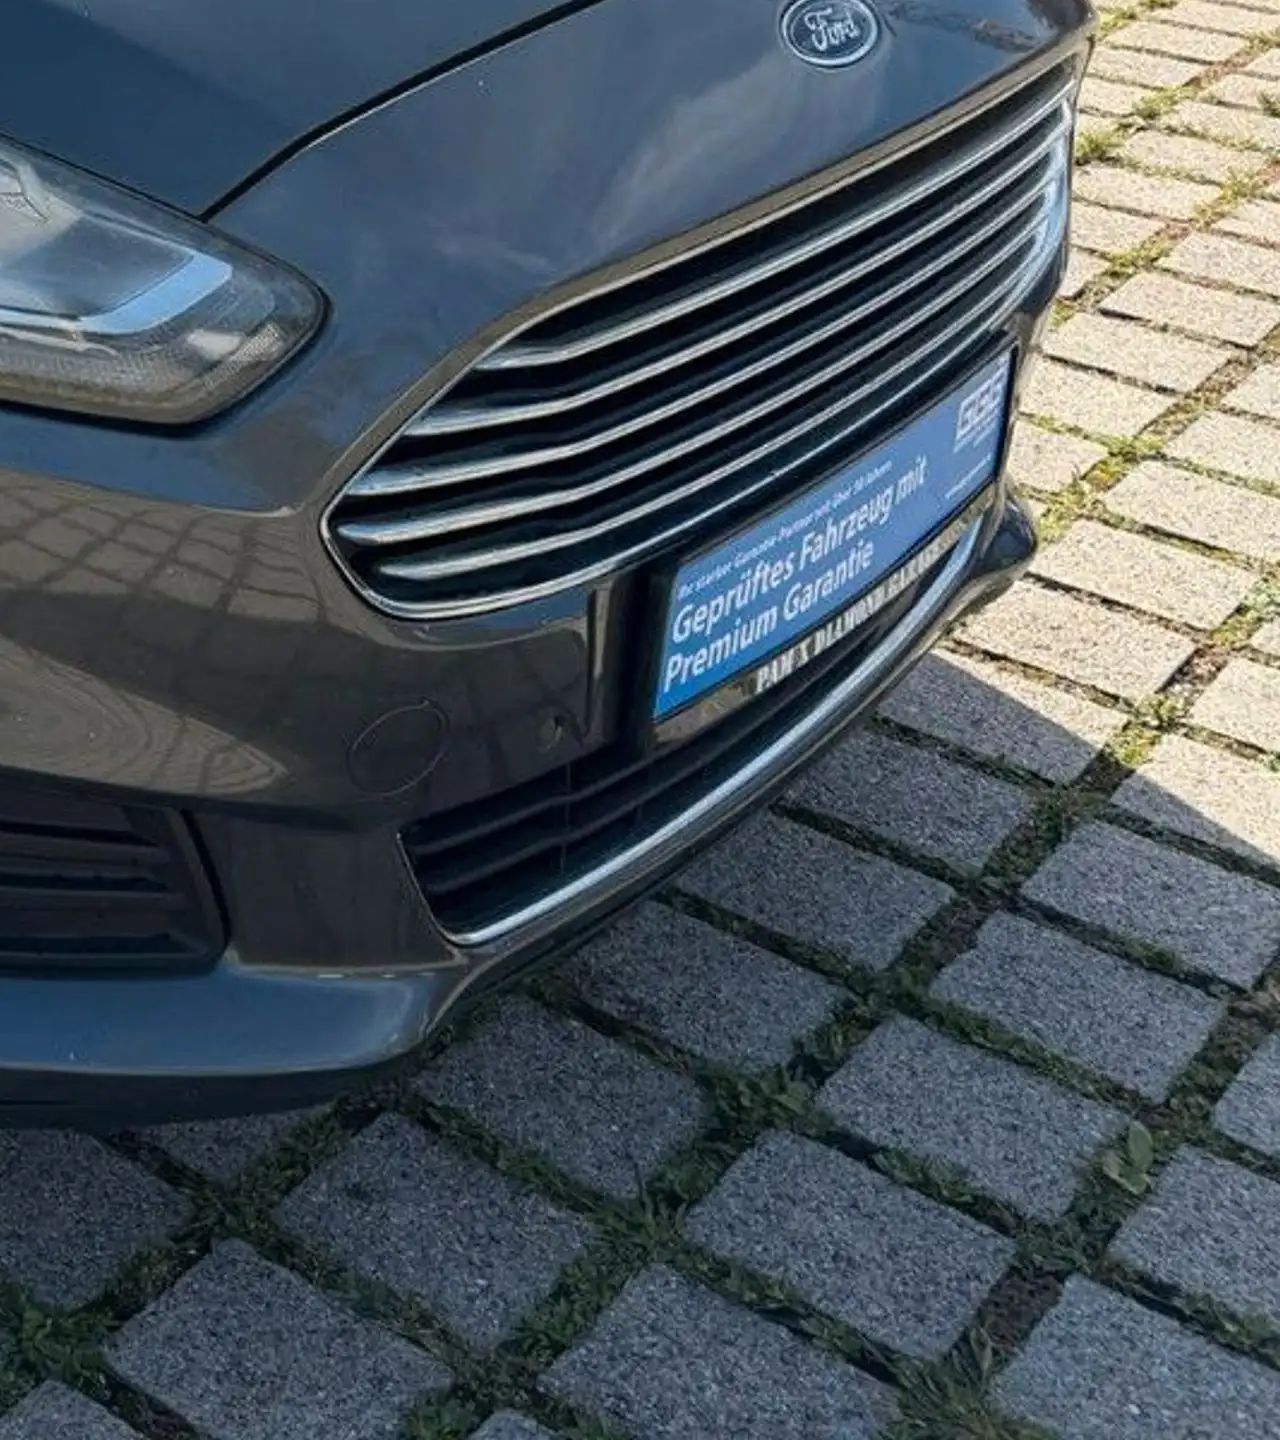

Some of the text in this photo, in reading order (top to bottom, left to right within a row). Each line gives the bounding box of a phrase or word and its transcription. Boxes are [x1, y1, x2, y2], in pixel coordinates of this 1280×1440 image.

[803, 7, 861, 52] Ford
[663, 605, 779, 693] Premium
[782, 539, 875, 621] Garantie
[672, 551, 796, 644] Geprüftes
[799, 484, 895, 571] Fahrzeug
[896, 454, 927, 505] mit
